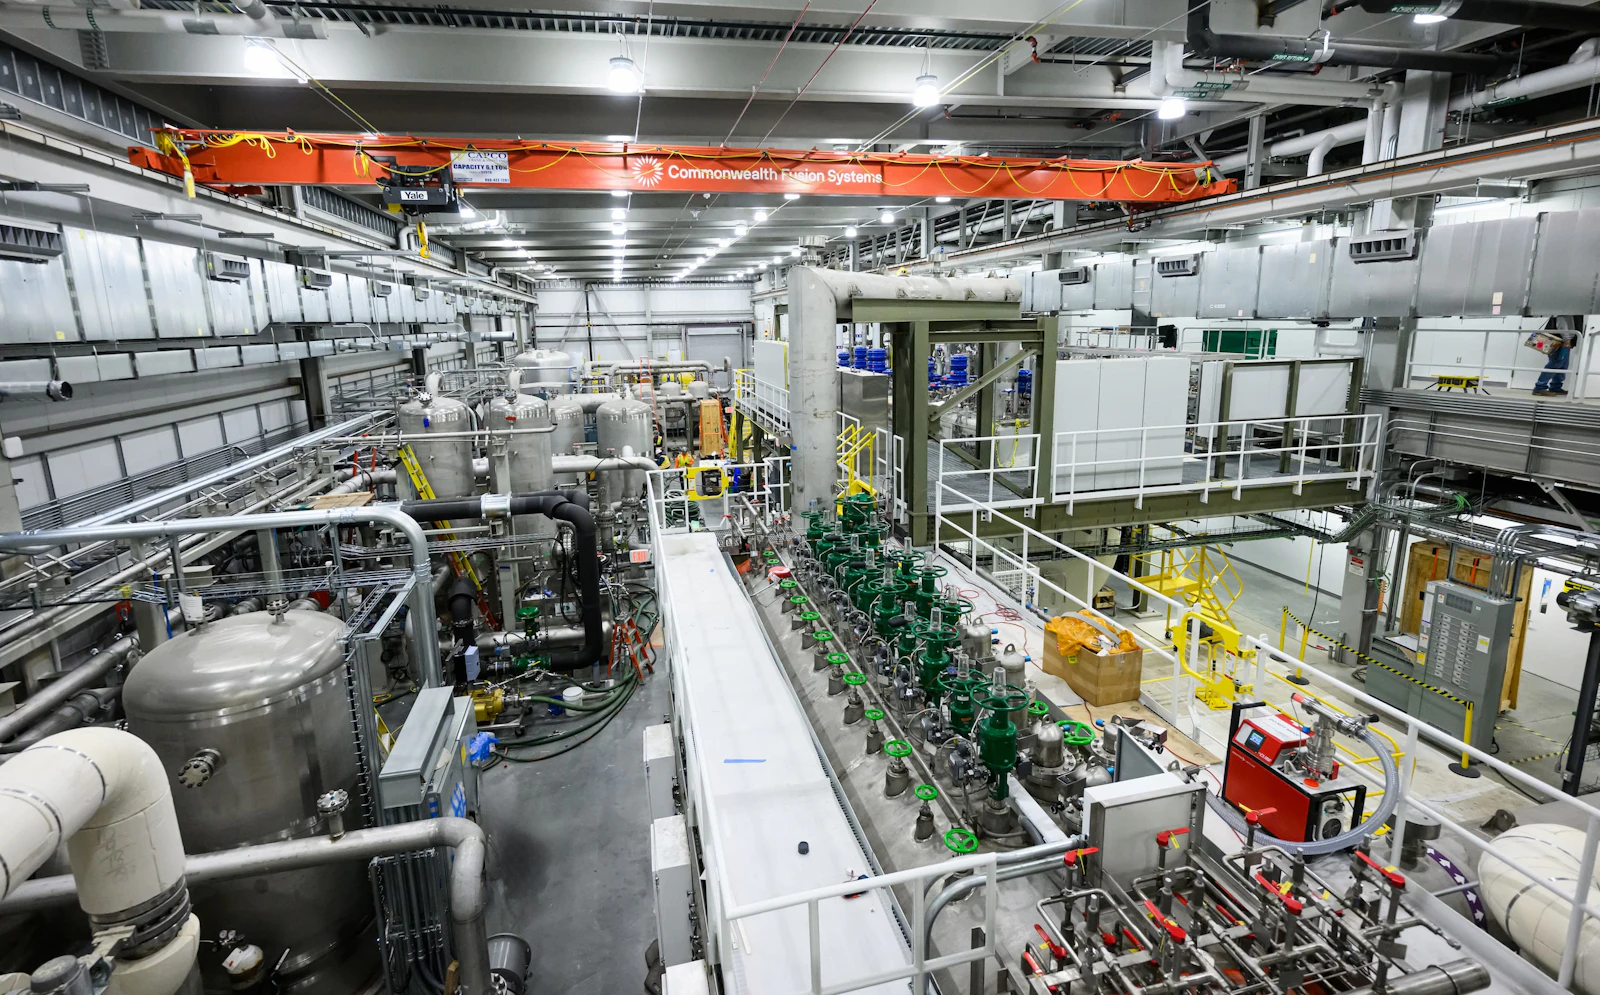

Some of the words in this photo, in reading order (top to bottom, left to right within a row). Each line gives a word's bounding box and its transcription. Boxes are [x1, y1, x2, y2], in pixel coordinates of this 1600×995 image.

[668, 164, 778, 180] Commonwealth
[781, 168, 825, 182] Fusion
[827, 169, 882, 185] Systems
[405, 191, 424, 199] Yale
[632, 551, 647, 562] EXIT
